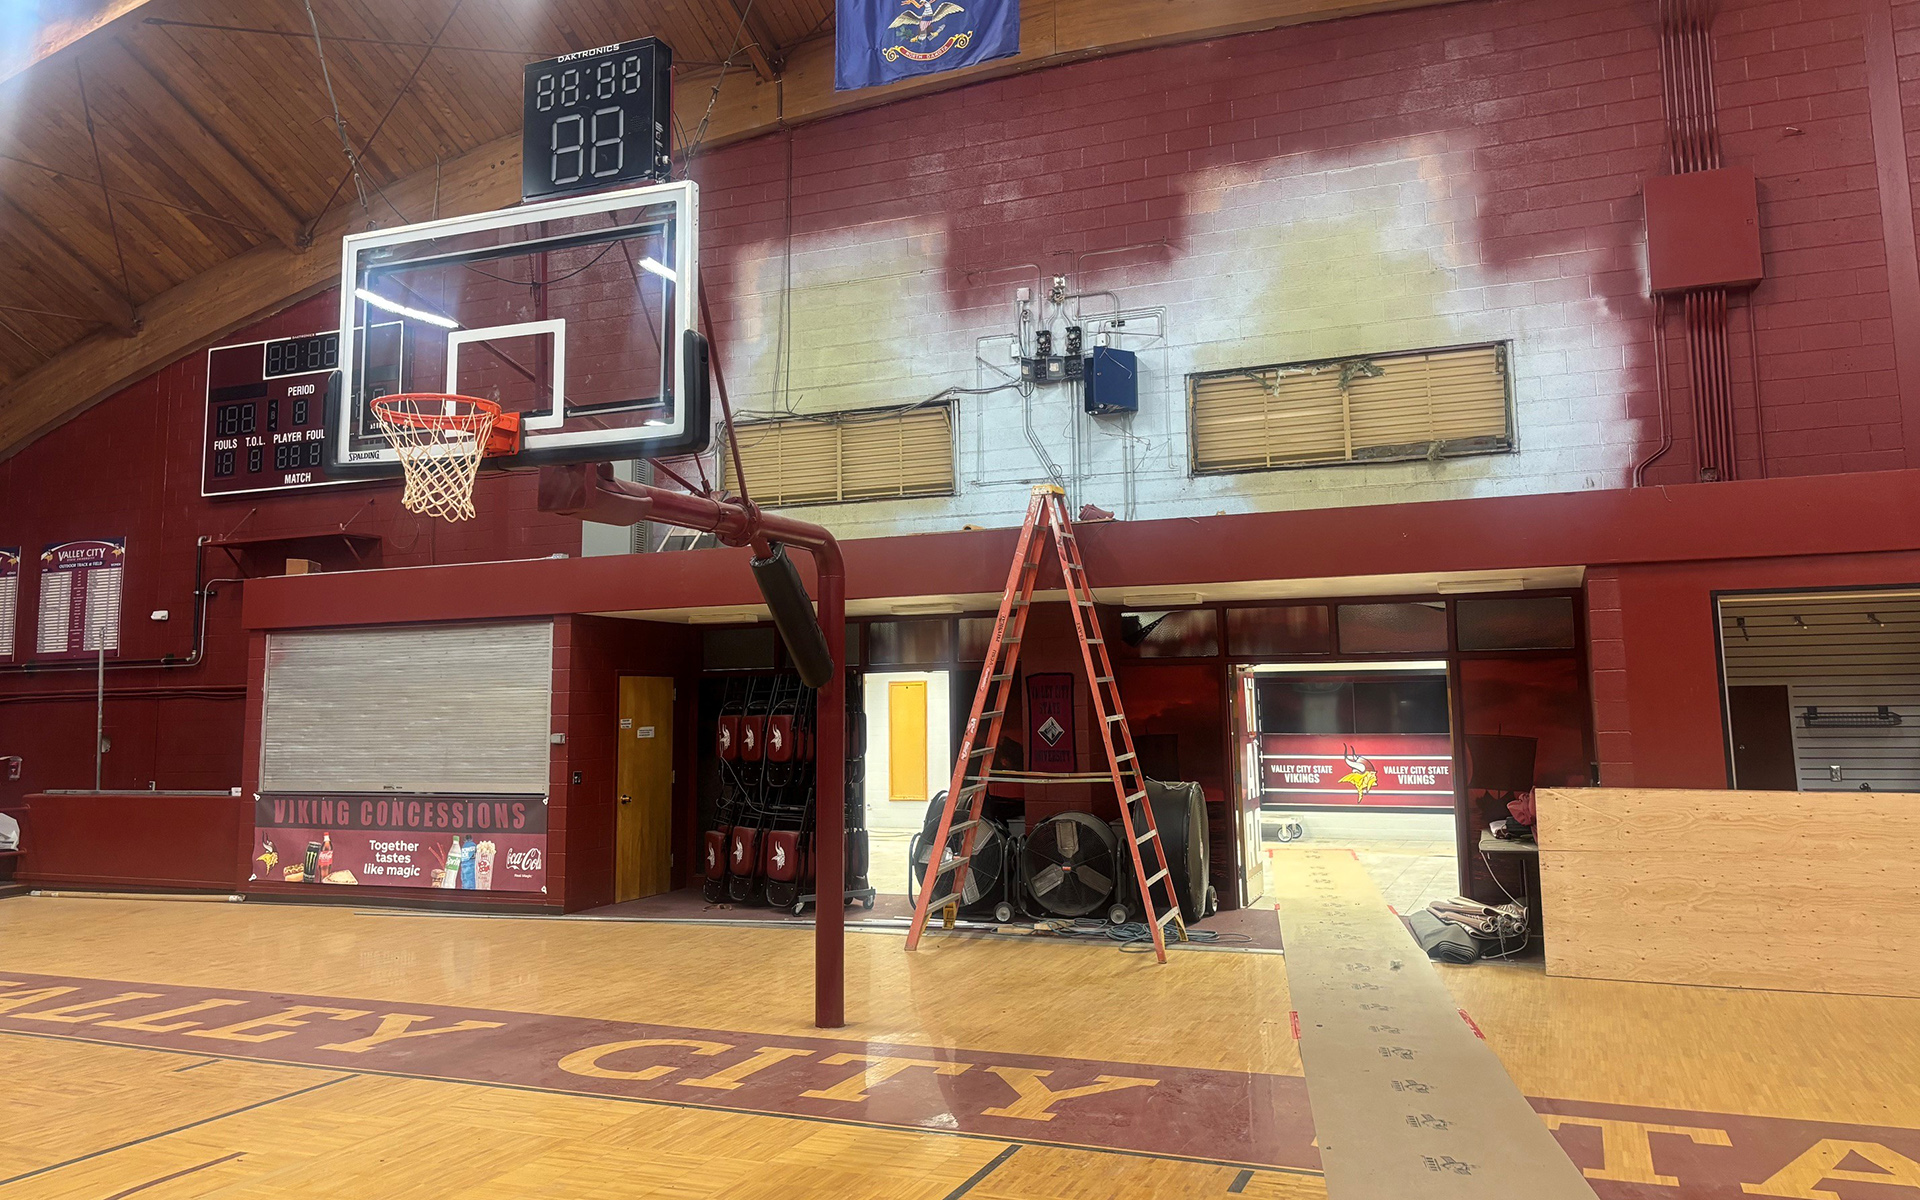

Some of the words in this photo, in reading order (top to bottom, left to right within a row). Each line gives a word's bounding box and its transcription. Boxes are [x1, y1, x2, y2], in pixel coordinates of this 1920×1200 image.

[557, 43, 620, 63] DAKTRONICS
[288, 384, 315, 397] PERIOD
[214, 438, 238, 450] FOULS
[245, 436, 266, 447] T.O.L.
[273, 432, 302, 444] PLAYER
[306, 429, 325, 440] FOUL
[348, 450, 380, 462] SPALDING
[284, 472, 311, 484] MATCH
[58, 549, 86, 562] VALLEY
[86, 548, 106, 558] CITY
[1270, 764, 1295, 773] VALLEY
[1296, 765, 1312, 774] CITY
[1313, 765, 1333, 774] STATE
[1383, 766, 1408, 774] VALLEY
[1410, 766, 1426, 774] CITY
[1427, 766, 1449, 775] STATE
[1284, 774, 1320, 783] VIKINGS
[1398, 774, 1436, 785] VIKINGS
[274, 800, 350, 826] VIKING
[360, 800, 526, 829] CONCESSIONS
[369, 840, 419, 852] Together
[376, 852, 411, 864] tastes
[364, 864, 384, 875] like
[386, 864, 420, 878] magic
[557, 1038, 1160, 1121] CITY
